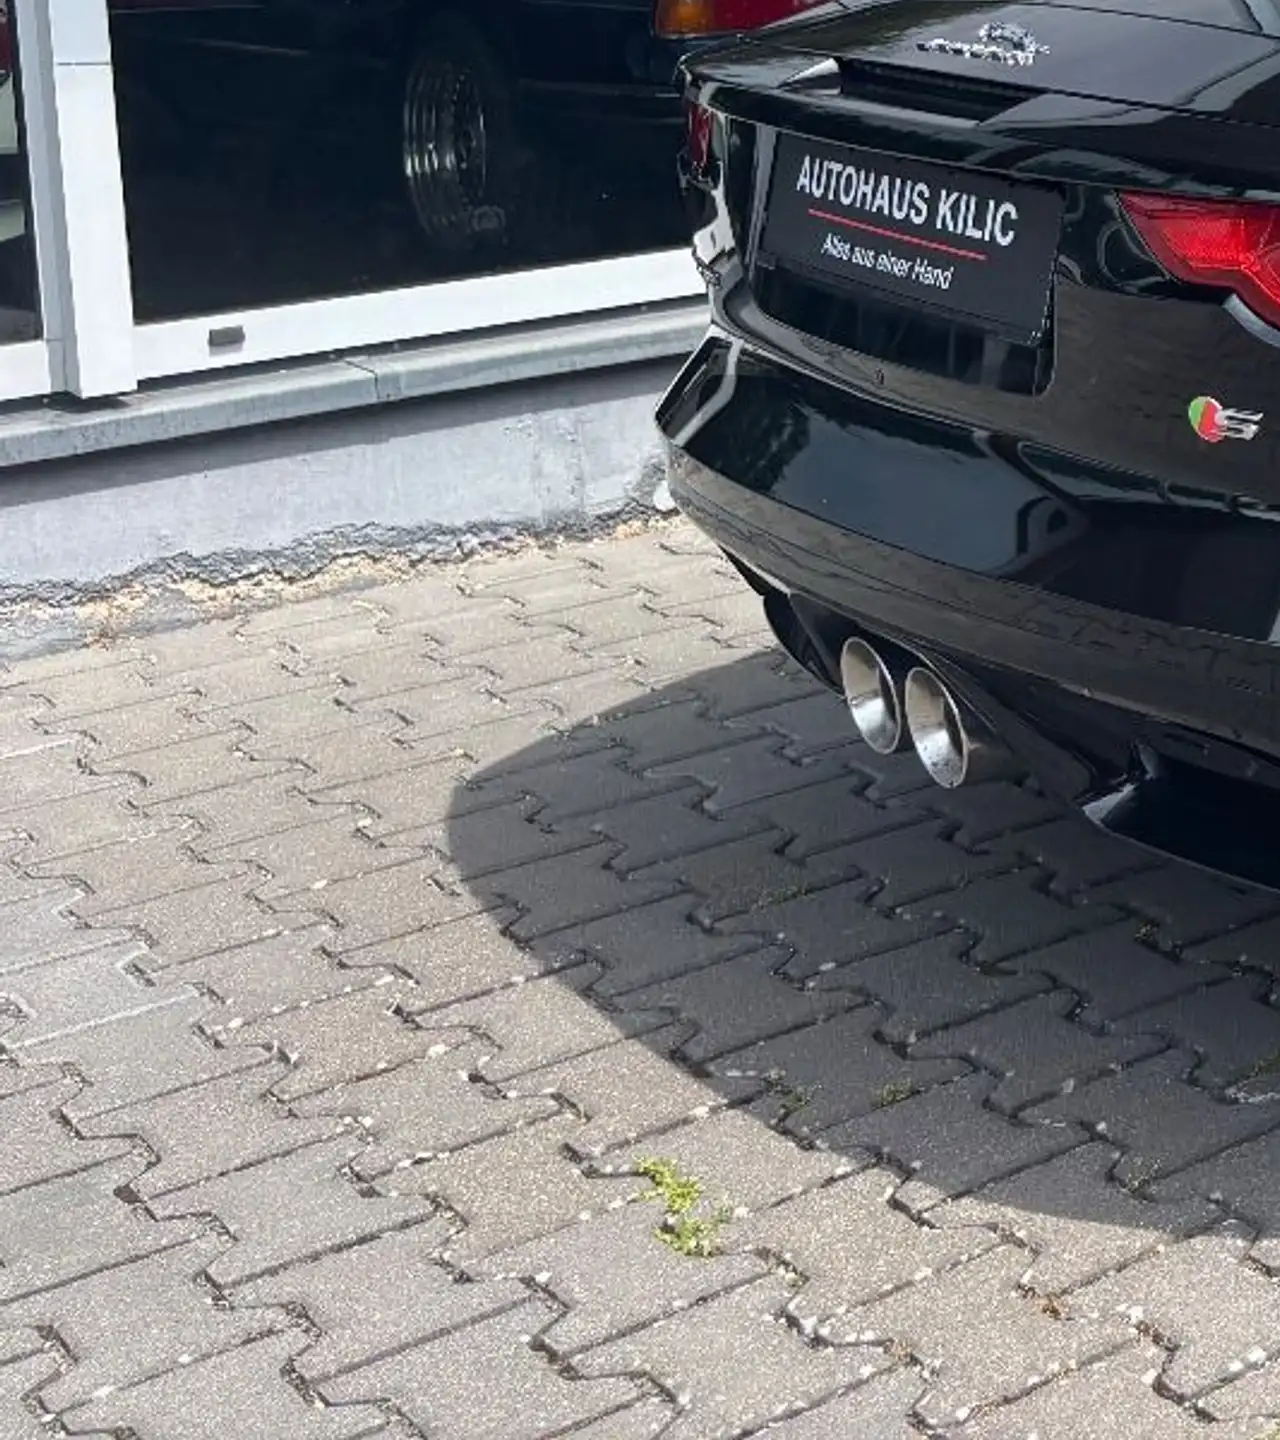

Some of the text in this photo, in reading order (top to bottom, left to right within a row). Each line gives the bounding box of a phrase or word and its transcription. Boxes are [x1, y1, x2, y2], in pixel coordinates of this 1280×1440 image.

[796, 154, 1018, 247] AUTOHAUS KILIC
[851, 246, 876, 268] aus
[876, 249, 913, 277] einer
[911, 257, 954, 290] Hand
